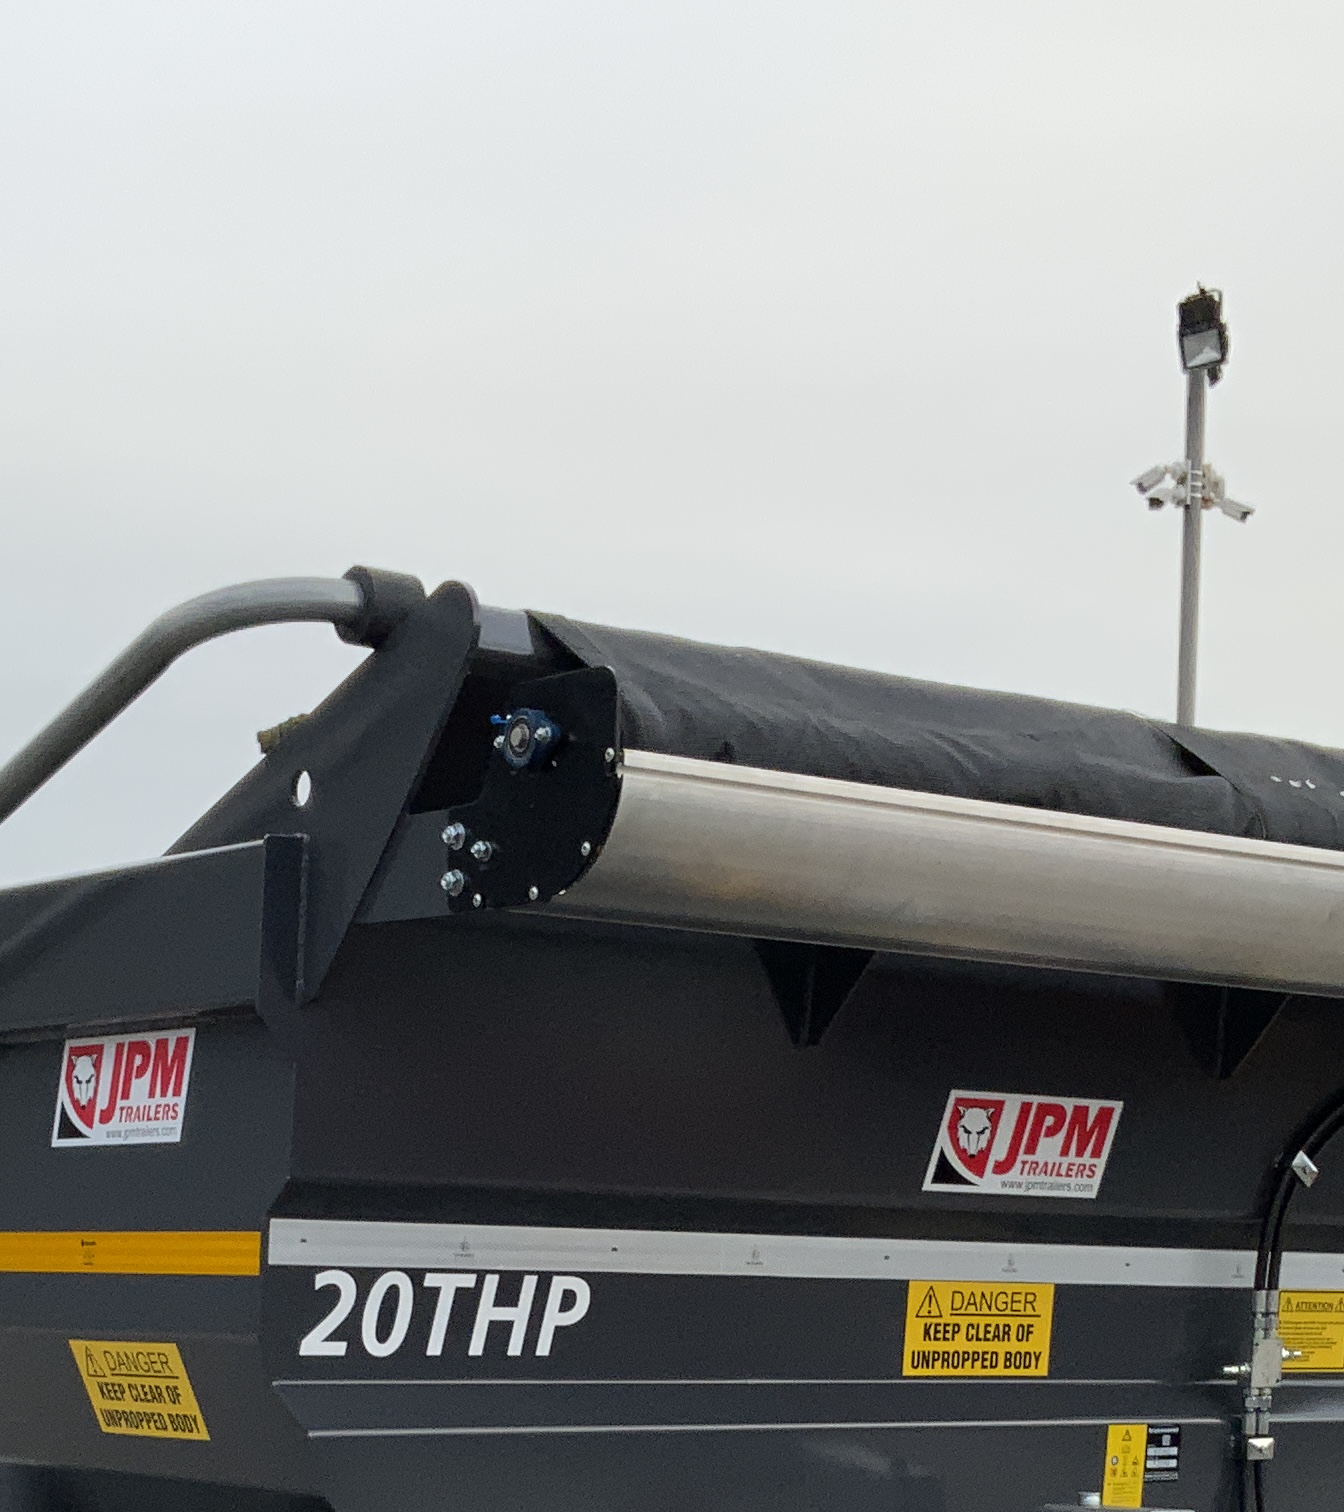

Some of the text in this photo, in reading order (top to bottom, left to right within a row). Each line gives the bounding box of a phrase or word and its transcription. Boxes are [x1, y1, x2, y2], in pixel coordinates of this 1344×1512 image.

[99, 1036, 190, 1125] JPM
[119, 1103, 179, 1123] TRAILERS
[992, 1102, 1115, 1175] JPM
[1019, 1160, 1097, 1179] TRAILERS
[1001, 1180, 1093, 1193] www.jpmtrailers.com
[950, 1290, 1037, 1313] DANGER
[299, 1269, 591, 1358] 20THP
[923, 1322, 1034, 1342] KEEP CLEAR OF
[103, 1350, 173, 1374] DANGER
[911, 1350, 1042, 1370] UNPROPPED BODY
[97, 1381, 183, 1405] KEEP CLEAR OF
[100, 1408, 201, 1434] UNPROPPED BODY
